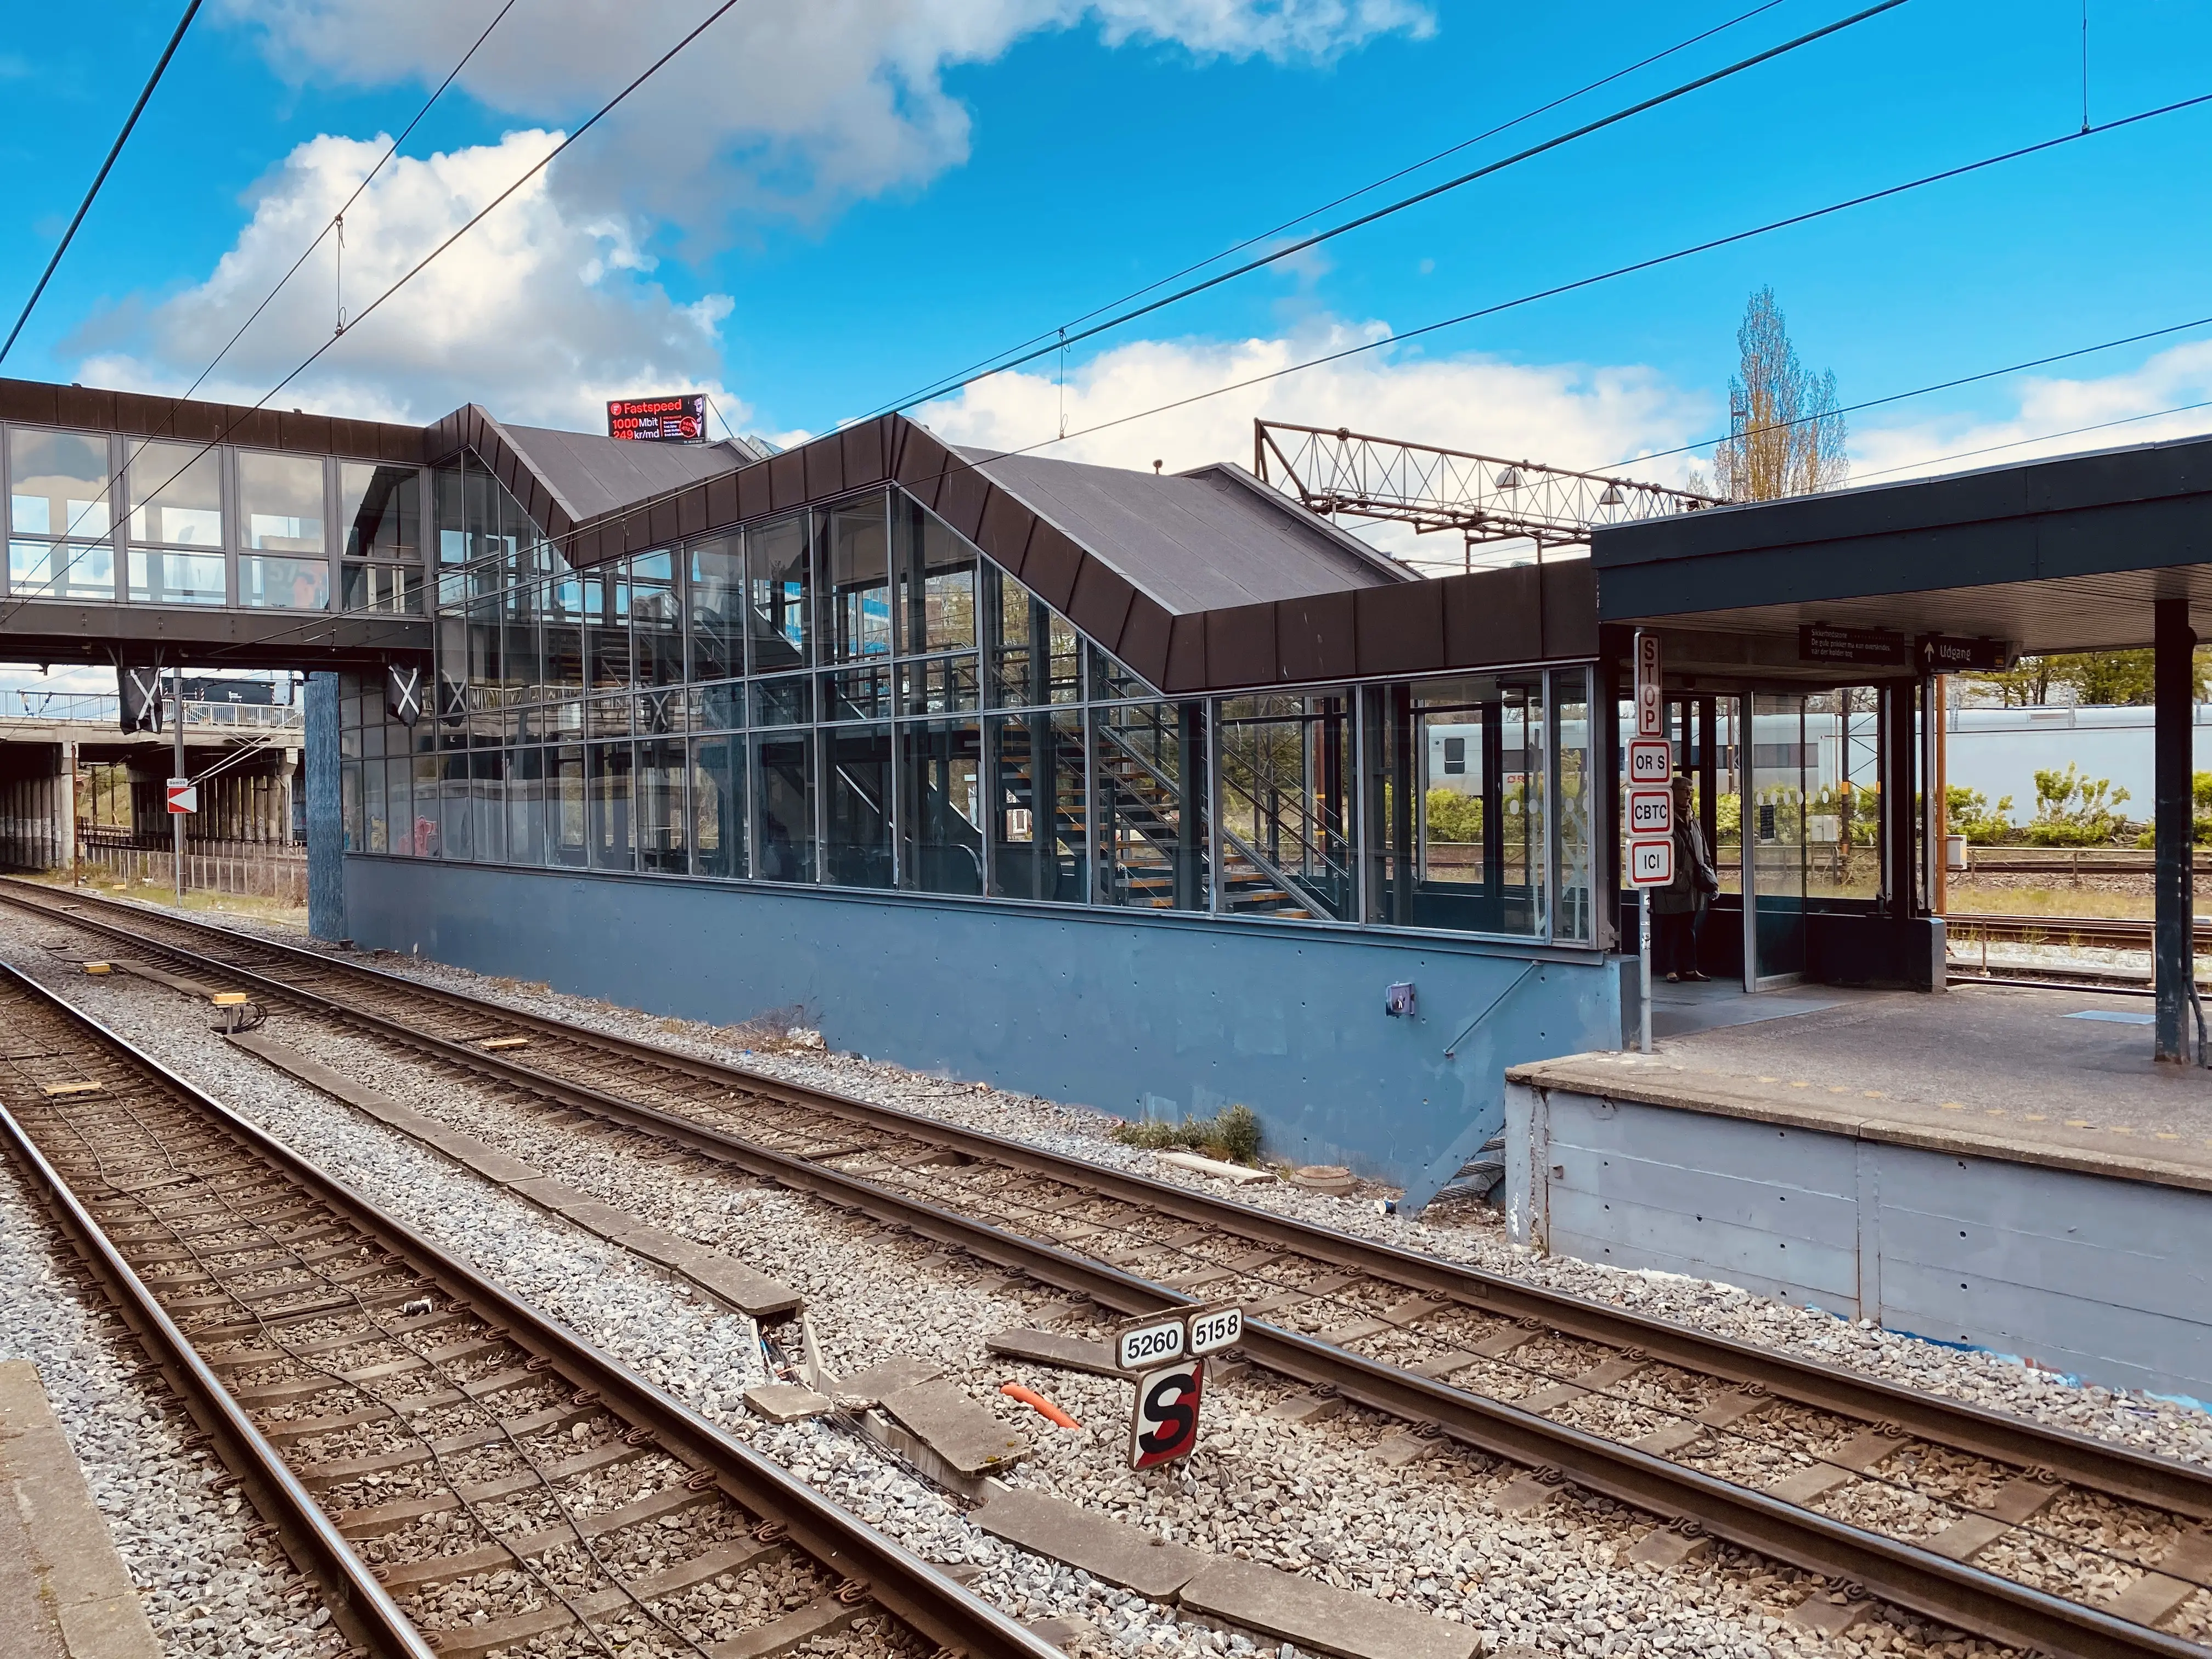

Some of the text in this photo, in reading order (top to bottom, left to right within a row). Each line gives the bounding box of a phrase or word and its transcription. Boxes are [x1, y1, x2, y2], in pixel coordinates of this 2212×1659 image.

[624, 398, 682, 415] Fastspeed
[1940, 645, 1971, 662] Udgang
[1644, 640, 1655, 730] STOP
[1635, 805, 1667, 820] CBTC
[1644, 854, 1660, 870] ICI
[1195, 1314, 1238, 1345] 5158
[1127, 1329, 1178, 1359] 5260
[1139, 1373, 1196, 1453] S
